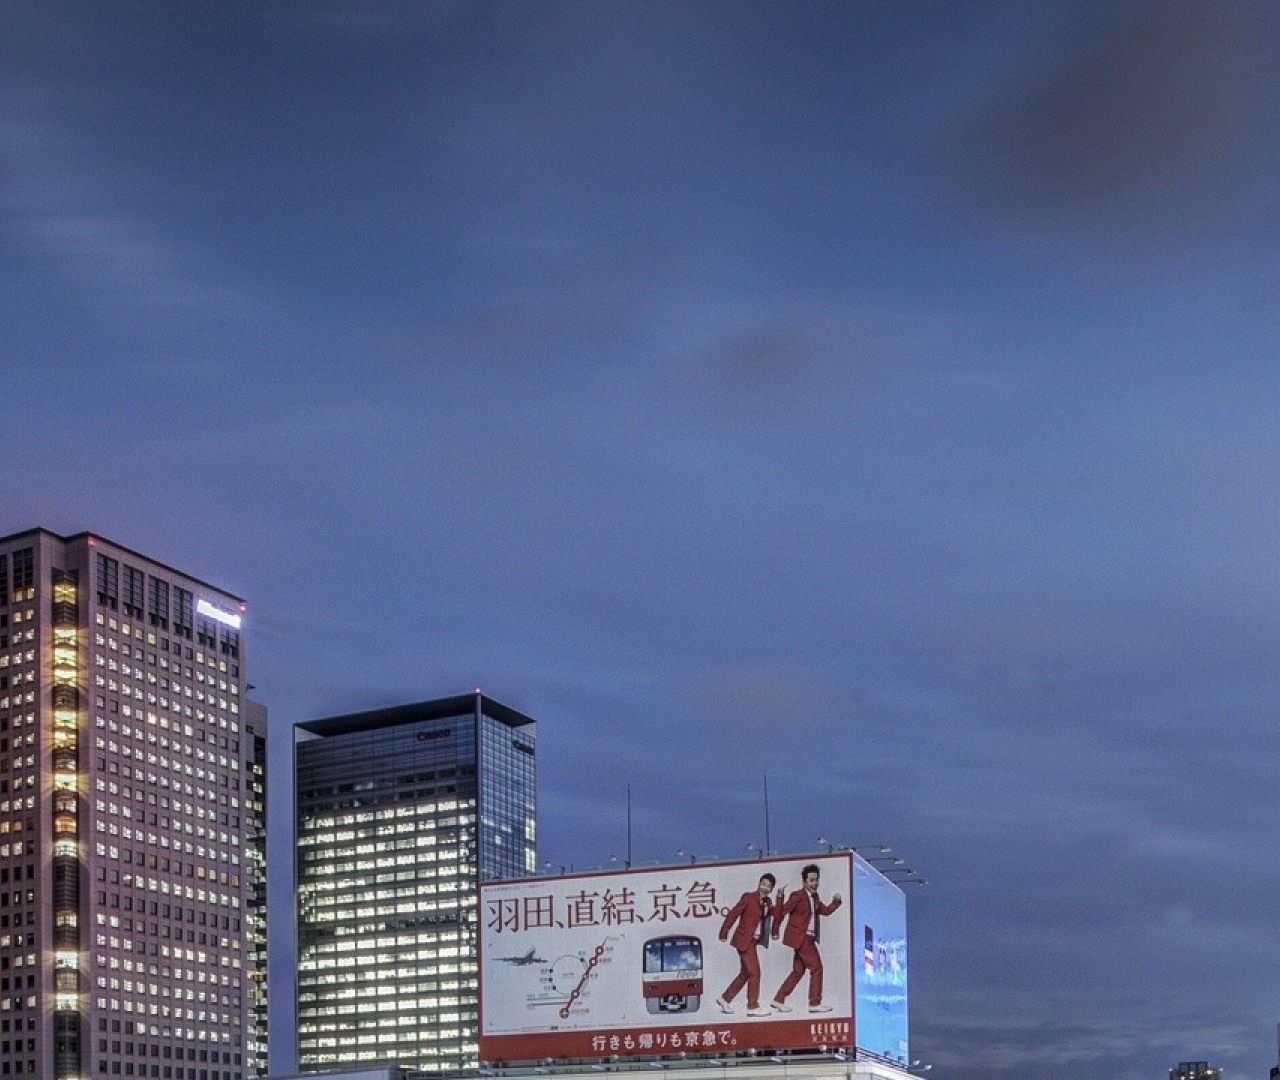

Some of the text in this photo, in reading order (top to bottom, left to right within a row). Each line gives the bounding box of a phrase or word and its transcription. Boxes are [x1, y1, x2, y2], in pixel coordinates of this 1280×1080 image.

[487, 882, 729, 933] 羽田、直結、京急。
[592, 1030, 737, 1051] 行きも帰りも京急で。
